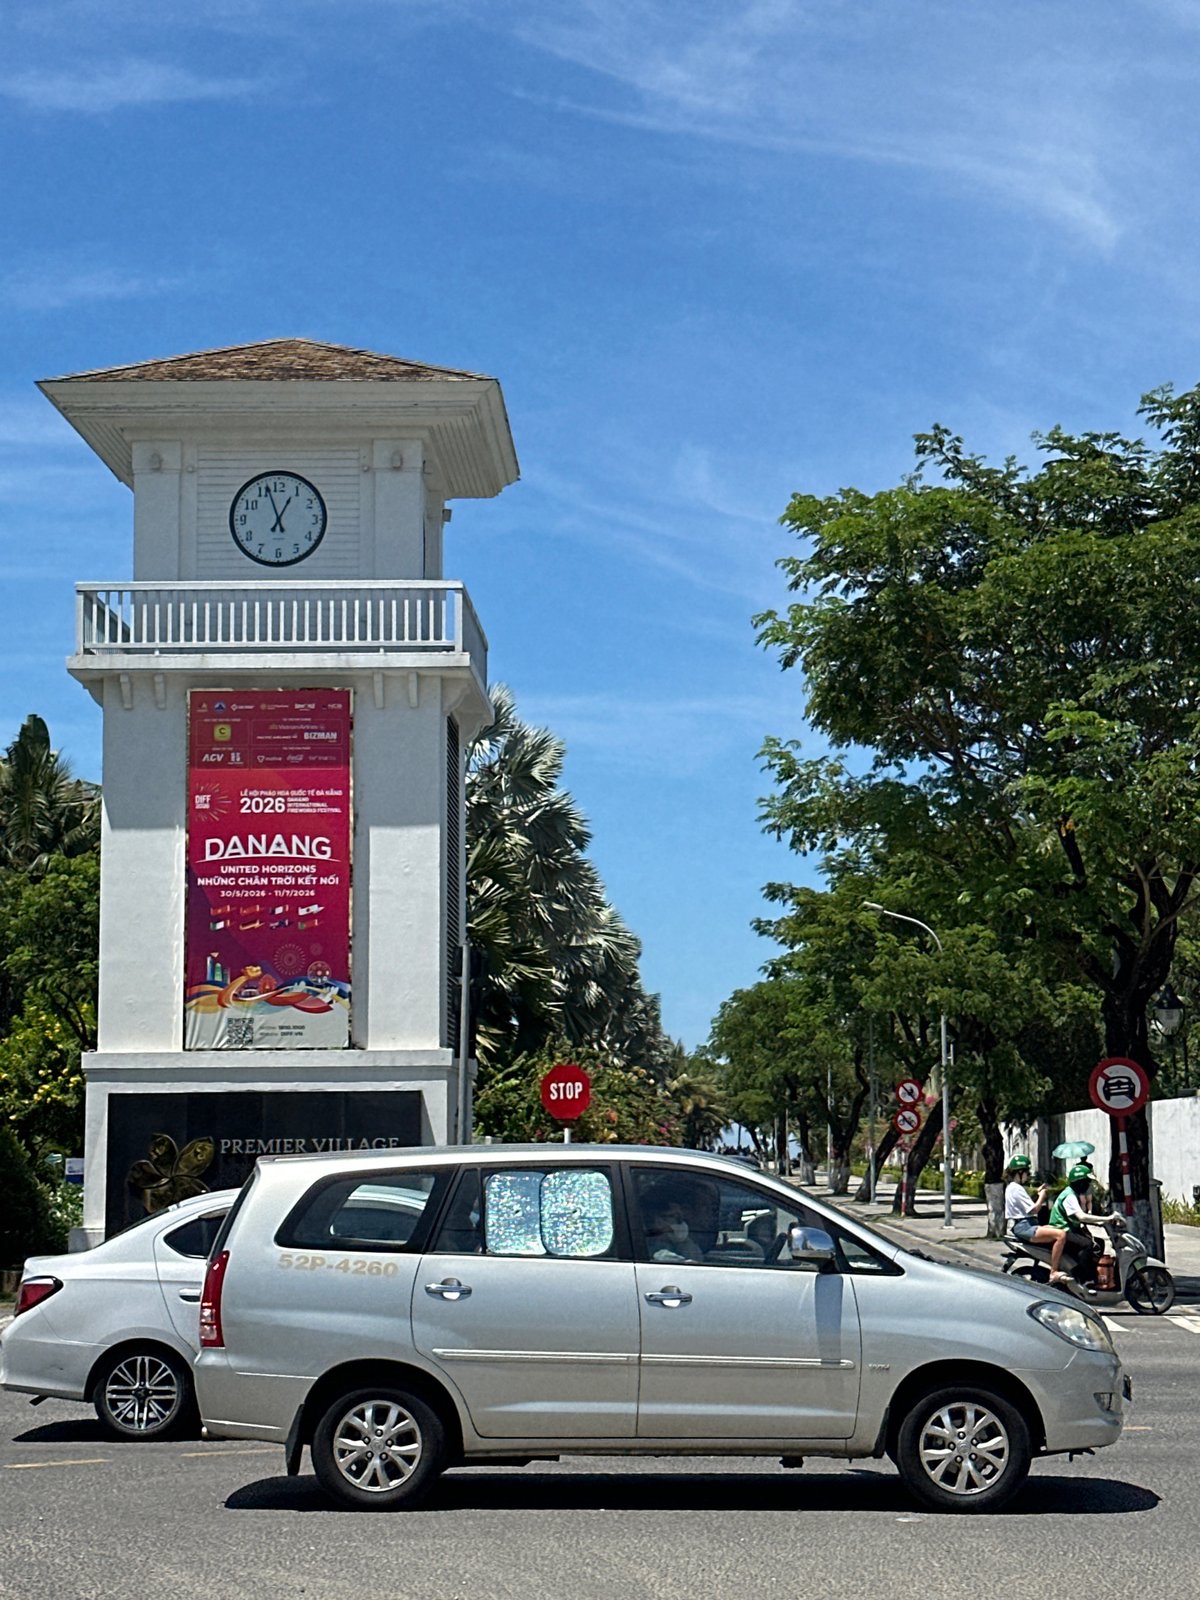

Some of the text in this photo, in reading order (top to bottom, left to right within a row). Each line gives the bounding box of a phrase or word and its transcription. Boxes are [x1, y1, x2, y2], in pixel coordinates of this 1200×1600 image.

[273, 481, 286, 493] 12
[295, 485, 299, 497] 1
[244, 499, 258, 511] 10
[306, 498, 313, 510] 2
[240, 514, 247, 526] 9
[311, 514, 319, 525] 3
[245, 530, 253, 542] 8
[304, 530, 312, 542] 4
[258, 543, 264, 554] 7
[275, 548, 282, 559] 6
[292, 543, 299, 554] 5
[303, 731, 337, 740] BIZMAN
[202, 753, 224, 762] ACV
[195, 794, 211, 804] DIFF
[240, 797, 286, 813] 2026
[205, 834, 332, 861] DANANG
[220, 864, 317, 874] UNITED HORIZONS
[197, 873, 339, 886] NHỮNG CHÂN TRỜI KẾT NỐI
[219, 889, 267, 898] 30/5/2026
[274, 889, 316, 897] 11/7/2026
[549, 1081, 583, 1101] STOP
[220, 1137, 399, 1154] PREMIER VILLAGE
[278, 1253, 399, 1278] 52P-4260
